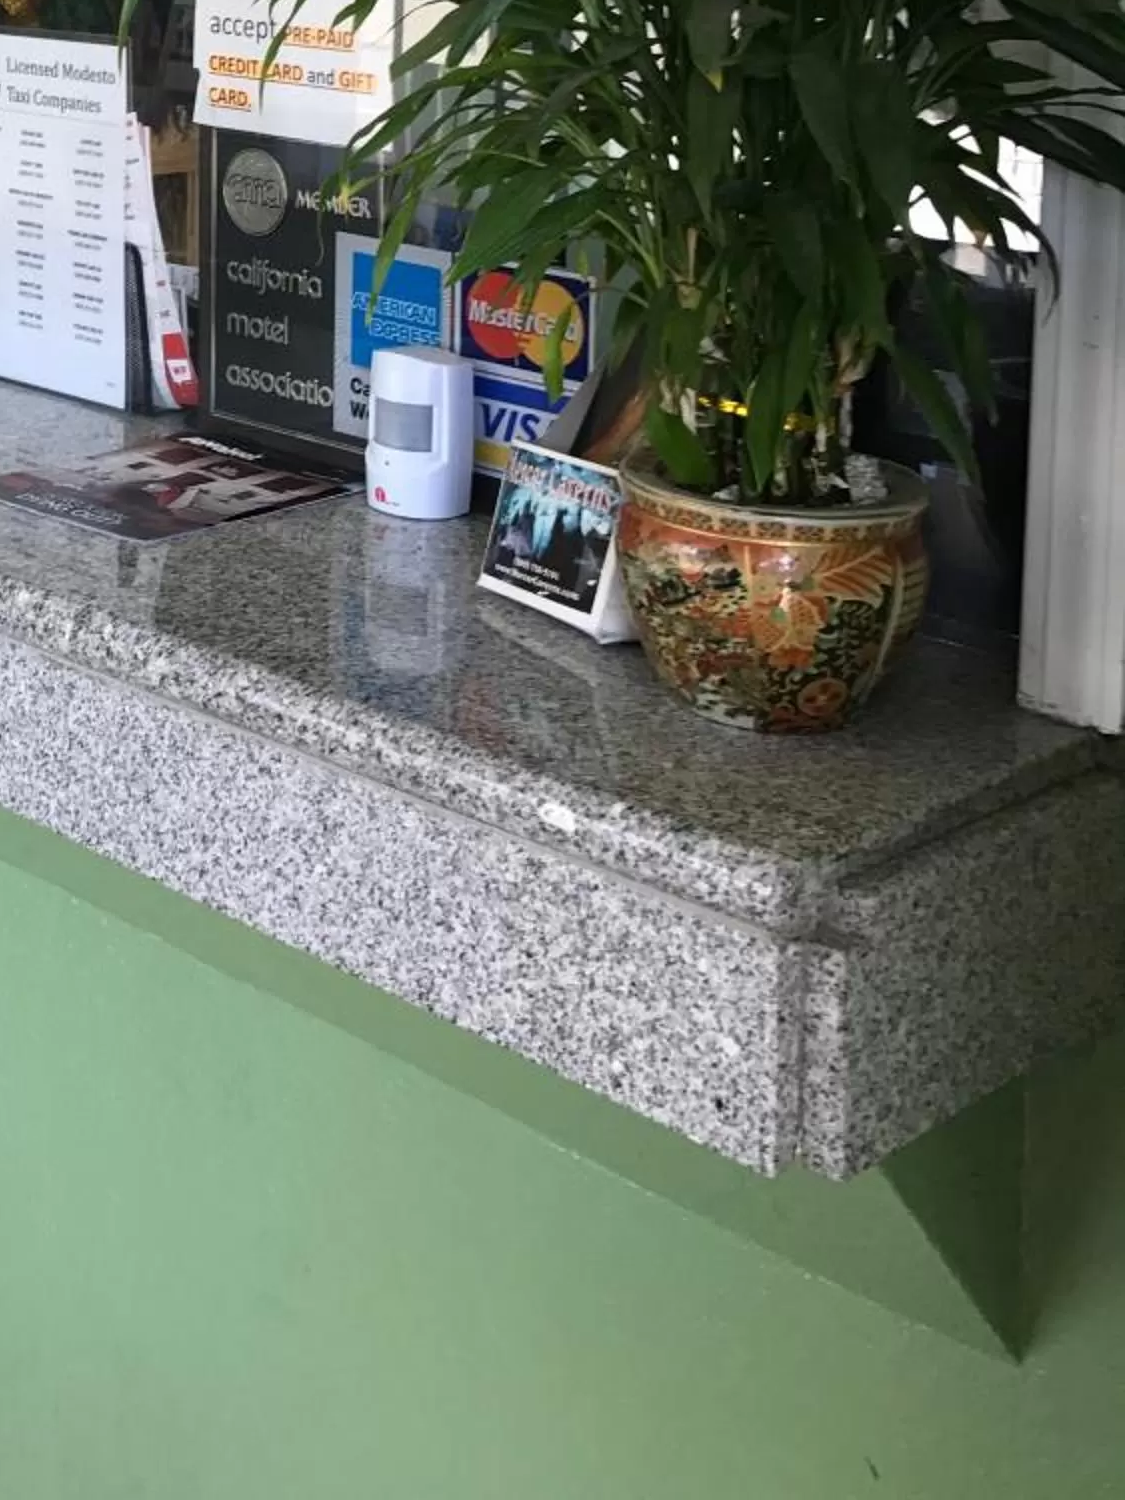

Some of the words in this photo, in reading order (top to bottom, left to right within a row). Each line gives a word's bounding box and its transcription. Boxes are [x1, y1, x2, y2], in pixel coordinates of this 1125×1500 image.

[210, 14, 276, 42] accept
[284, 25, 354, 48] PRE-PAID
[5, 55, 60, 78] Licensed
[61, 62, 116, 85] Modesto
[208, 54, 259, 76] CREDIT
[264, 62, 303, 82] ARD
[307, 67, 335, 86] and
[338, 71, 375, 89] GIFT
[6, 86, 30, 104] Taxi
[32, 89, 103, 113] Companies
[208, 87, 252, 107] CARD.
[226, 257, 323, 299] california
[226, 310, 289, 345] motel
[468, 297, 582, 342] MasterCad
[226, 363, 334, 408] associatio
[481, 403, 545, 443] VIS
